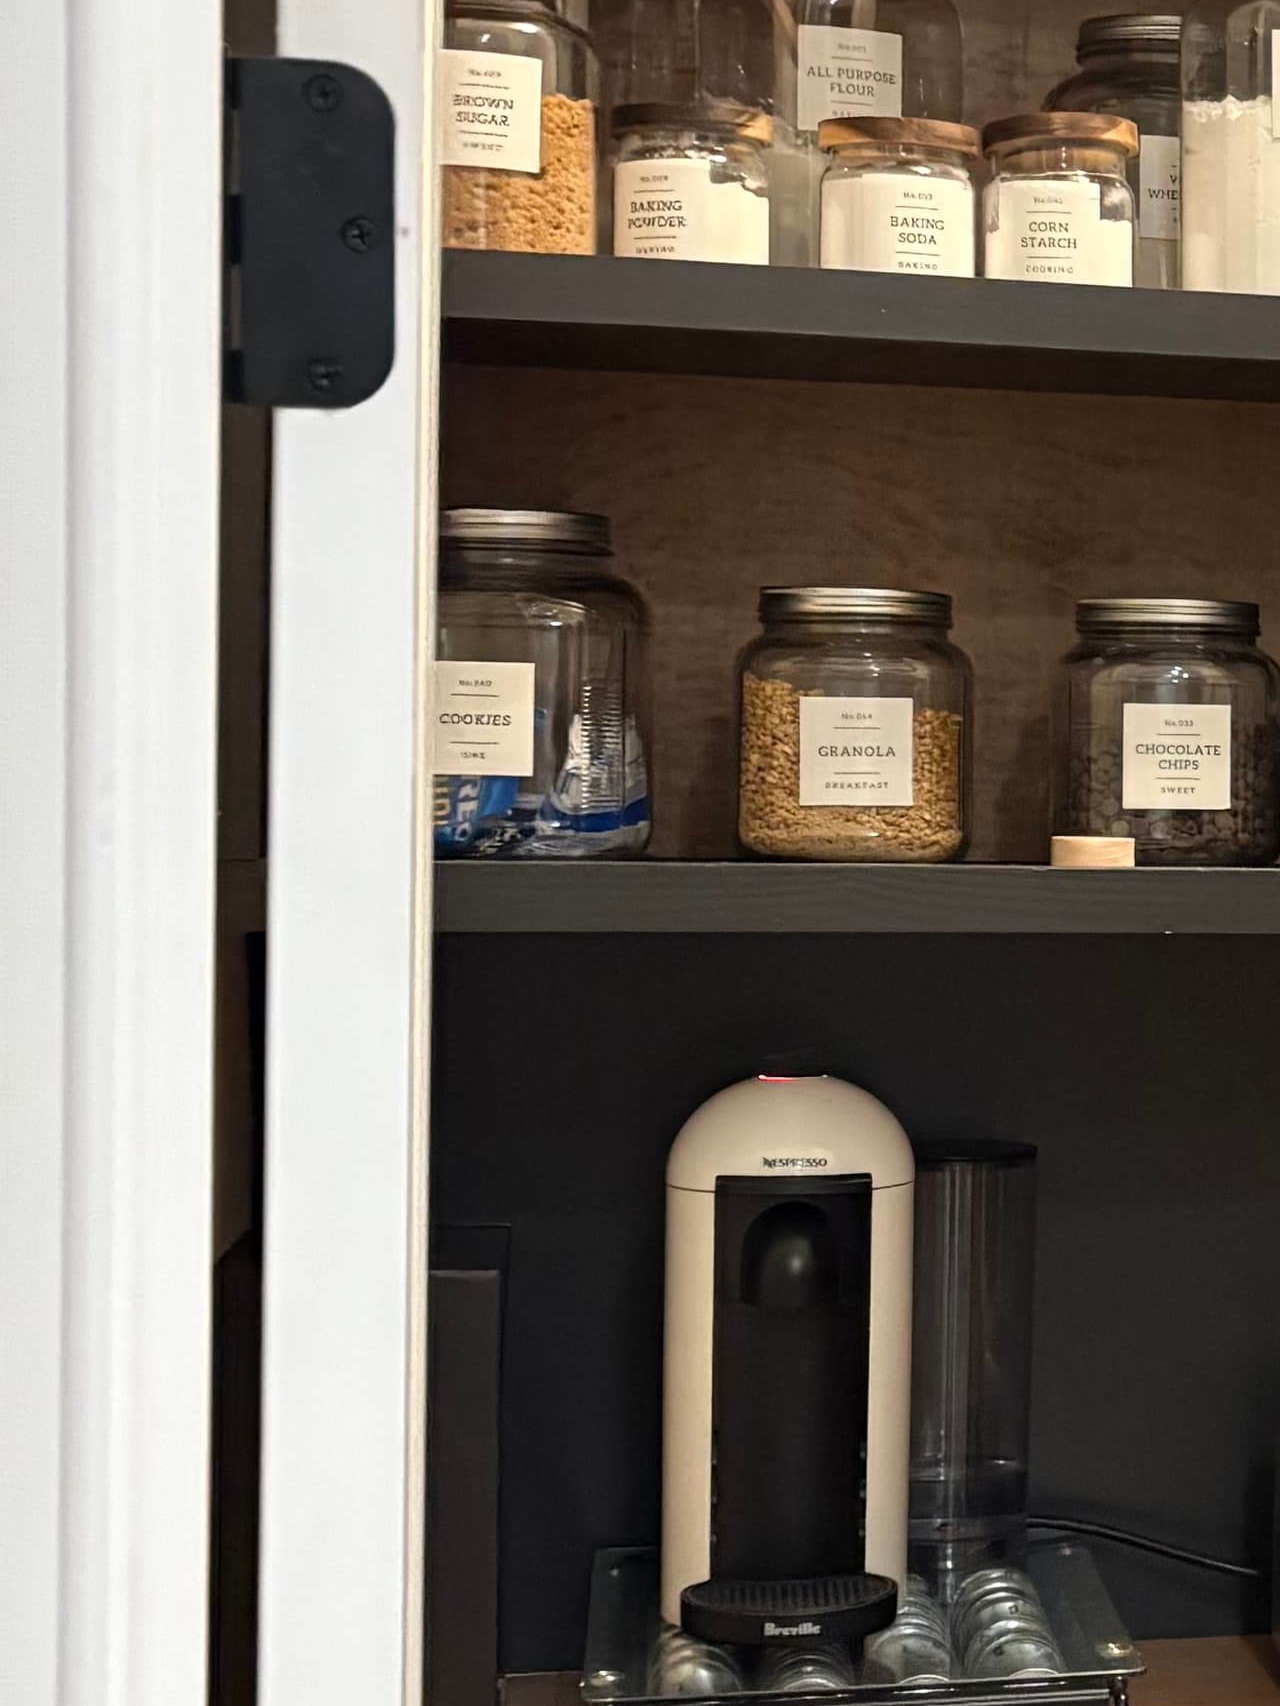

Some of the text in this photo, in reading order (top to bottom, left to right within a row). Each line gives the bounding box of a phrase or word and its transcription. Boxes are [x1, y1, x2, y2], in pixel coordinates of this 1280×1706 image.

[806, 66, 897, 84] ALL PURPOSE
[830, 82, 875, 97] FLOUR
[453, 94, 514, 110] BROWN
[455, 111, 510, 126] SUGAR
[1148, 188, 1179, 200] WHE
[630, 200, 682, 214] BAKING
[627, 216, 687, 230] POWDER
[890, 215, 945, 231] BAKING
[1028, 221, 1069, 233] CORN
[898, 232, 937, 245] SODA
[1020, 237, 1077, 249] STARCH
[439, 713, 512, 726] COOKIES
[818, 745, 896, 757] GRANOLA
[1135, 743, 1222, 756] CHOCOLATE
[1158, 759, 1200, 770] CHIPS
[825, 781, 889, 790] BREAKFAST
[1160, 786, 1196, 794] SWEET
[454, 782, 480, 842] REO
[762, 1157, 828, 1169] NESPRESSO
[764, 1621, 821, 1636] Breville
